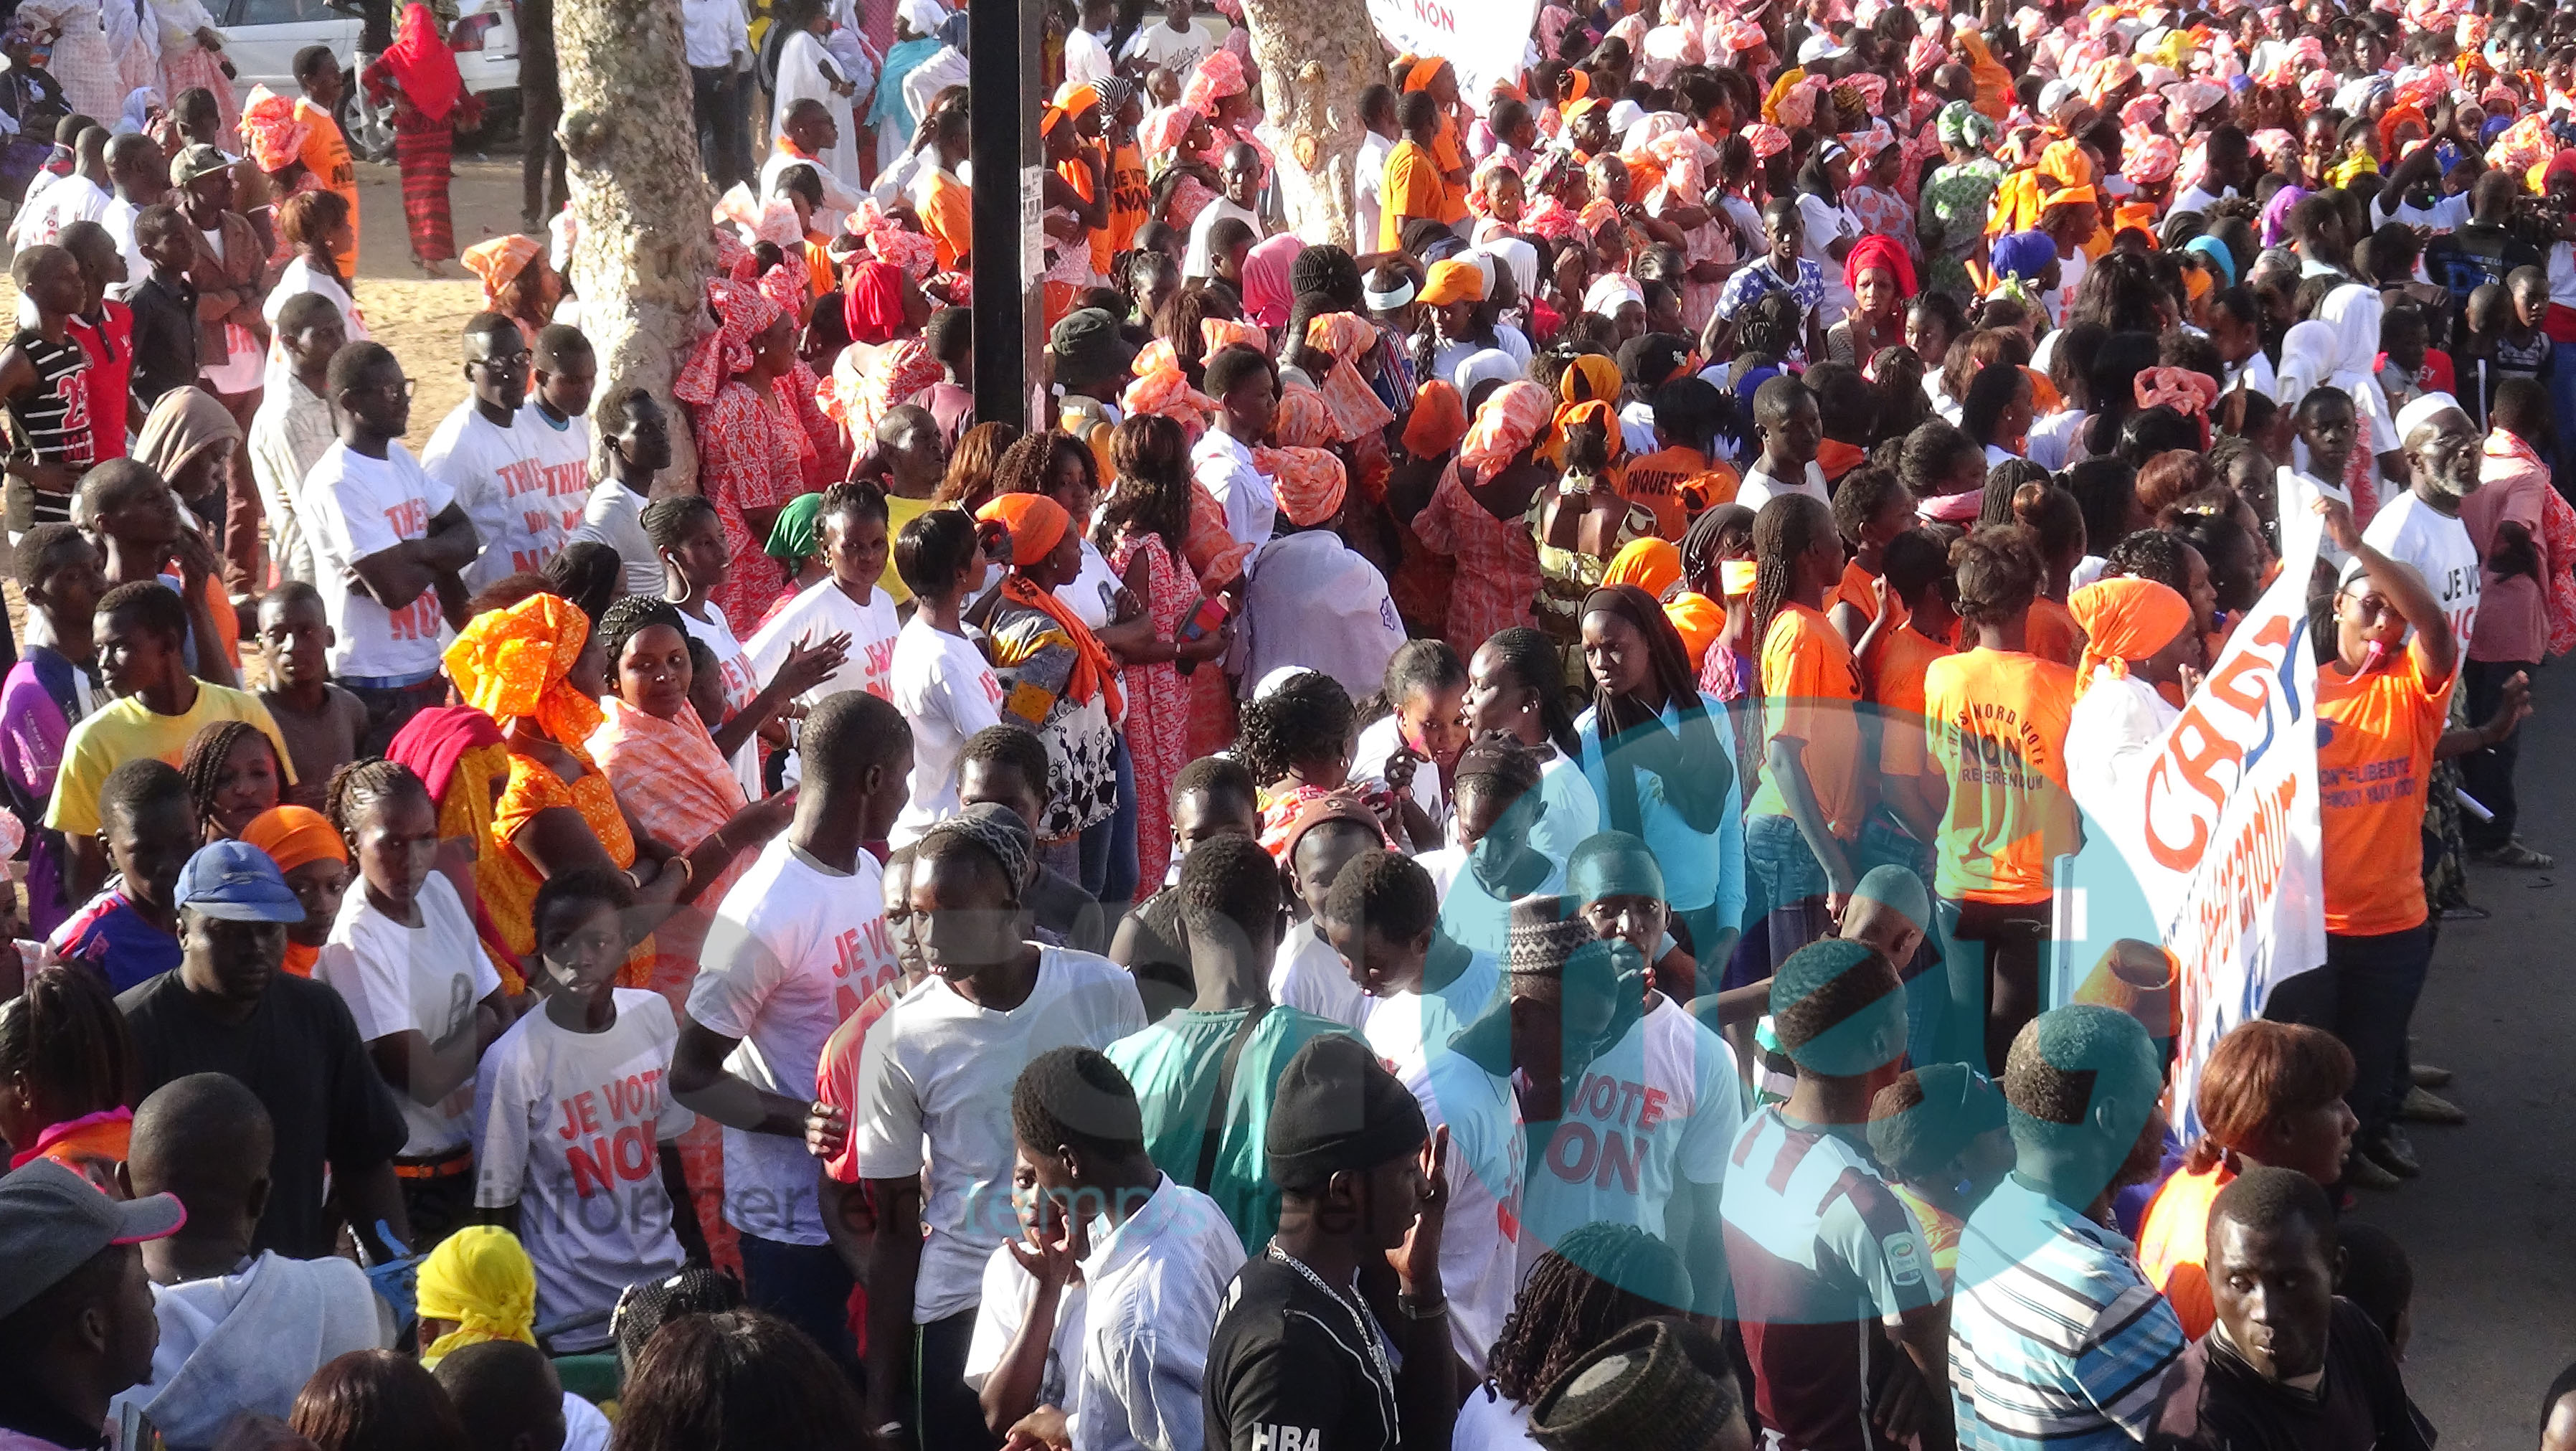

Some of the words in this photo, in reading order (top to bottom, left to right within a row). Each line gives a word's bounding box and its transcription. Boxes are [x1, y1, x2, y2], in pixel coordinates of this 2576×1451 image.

[1961, 729, 2022, 770] NON
[1973, 704, 2017, 726] NORD
[2019, 720, 2045, 766] VOTE
[1962, 767, 2043, 790] REFERENDUM
[832, 927, 868, 978] JE
[558, 1090, 602, 1140] JE
